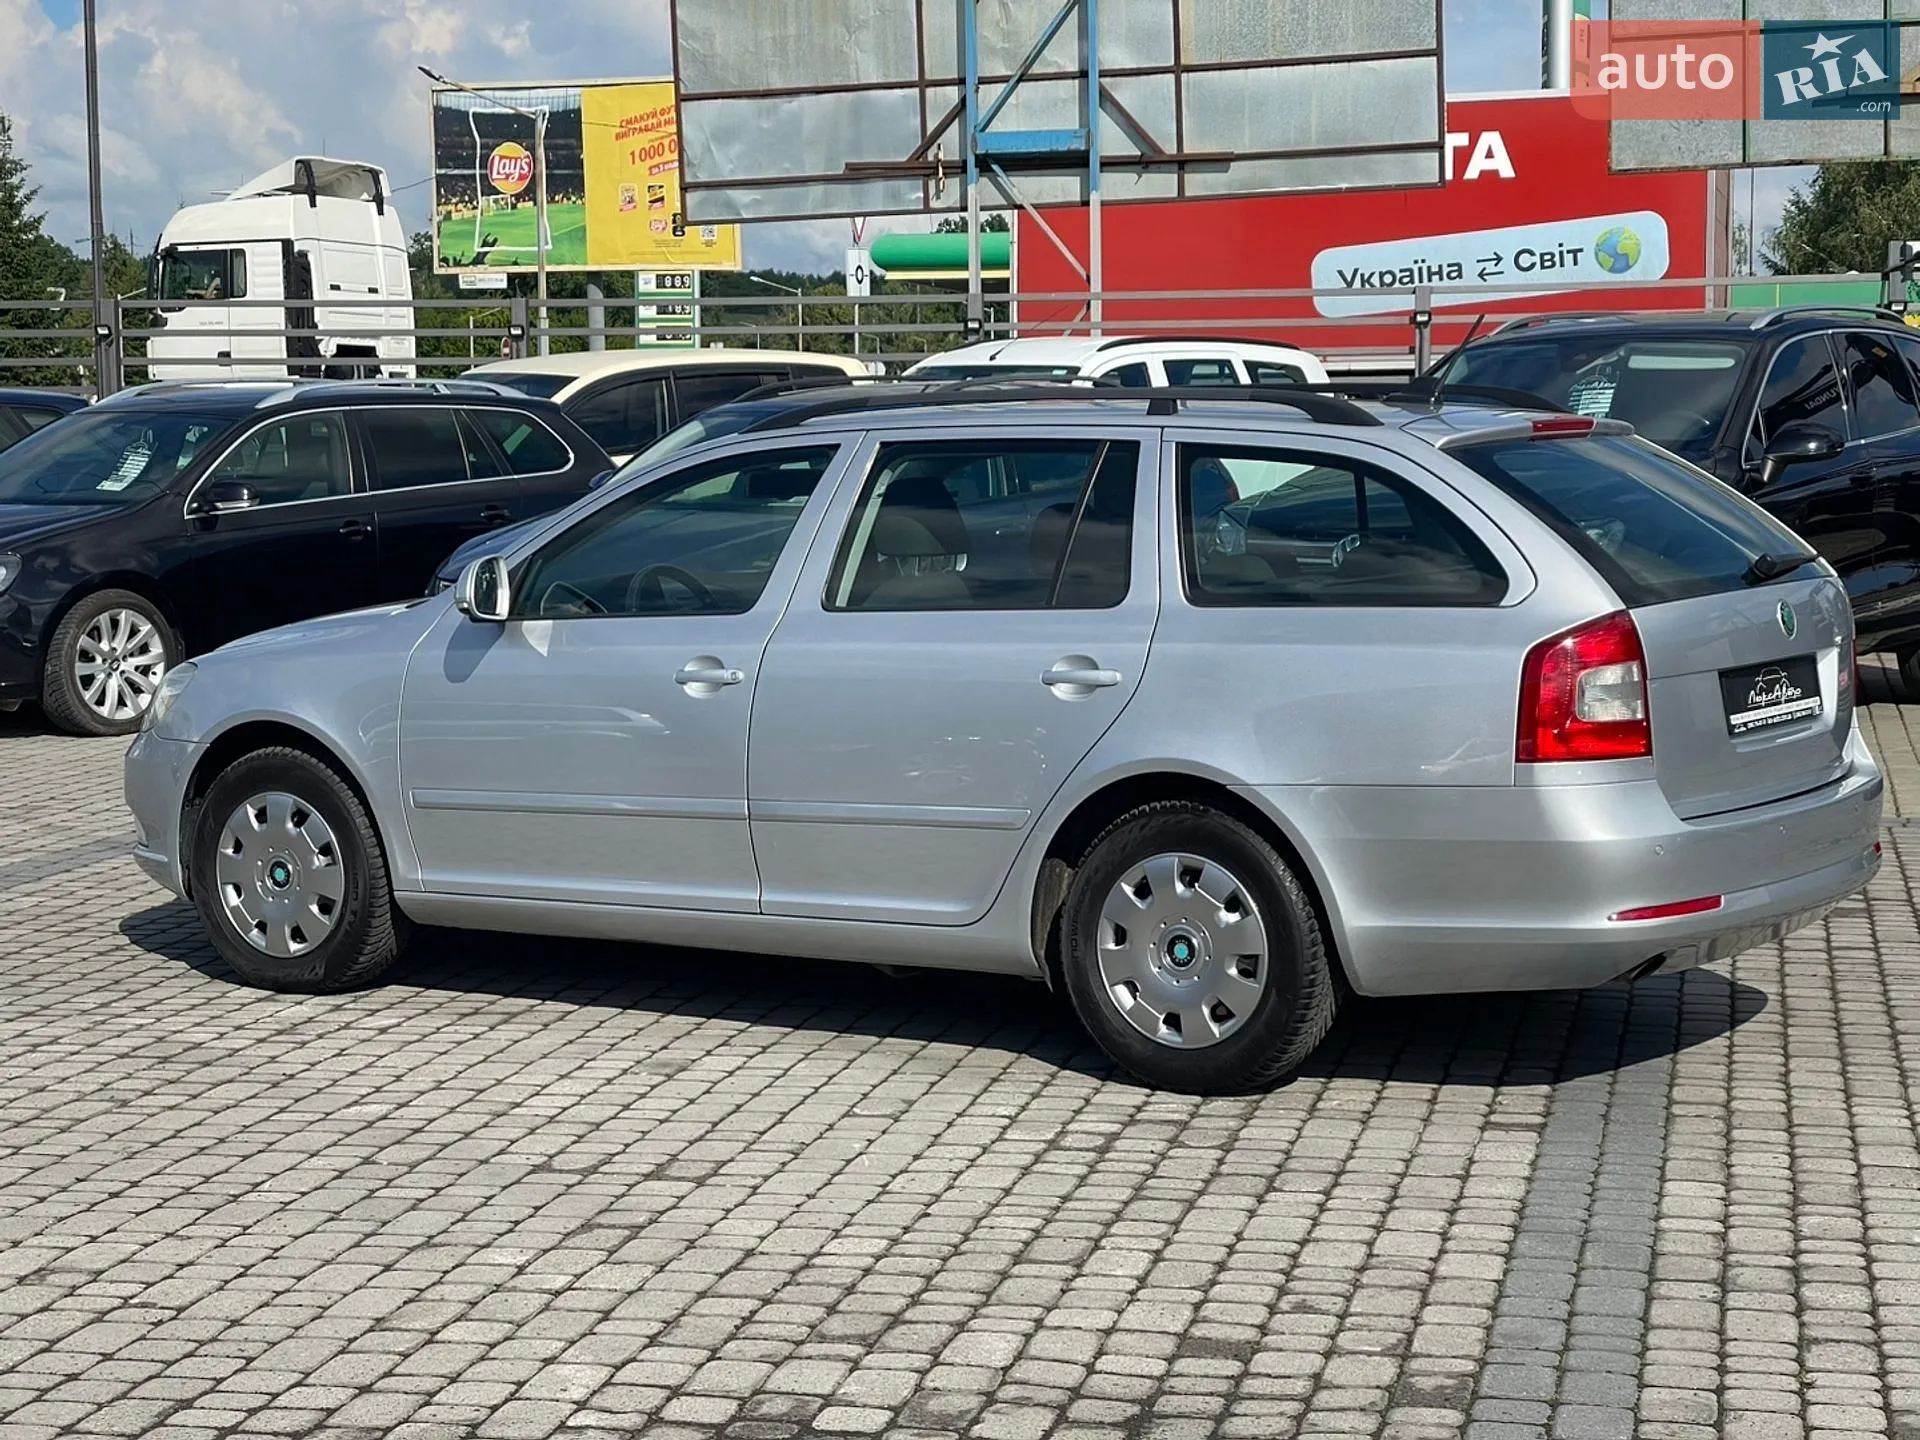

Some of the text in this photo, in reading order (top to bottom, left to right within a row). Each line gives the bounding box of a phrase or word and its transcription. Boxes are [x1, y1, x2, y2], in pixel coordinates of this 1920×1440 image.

[615, 119, 662, 141] ВИГРАВАЙ
[664, 116, 677, 127] МІ
[620, 107, 658, 128] СМАКУЙ
[668, 138, 678, 154] 0
[1445, 130, 1516, 181] ТА
[1336, 243, 1585, 288] Україна Світ
